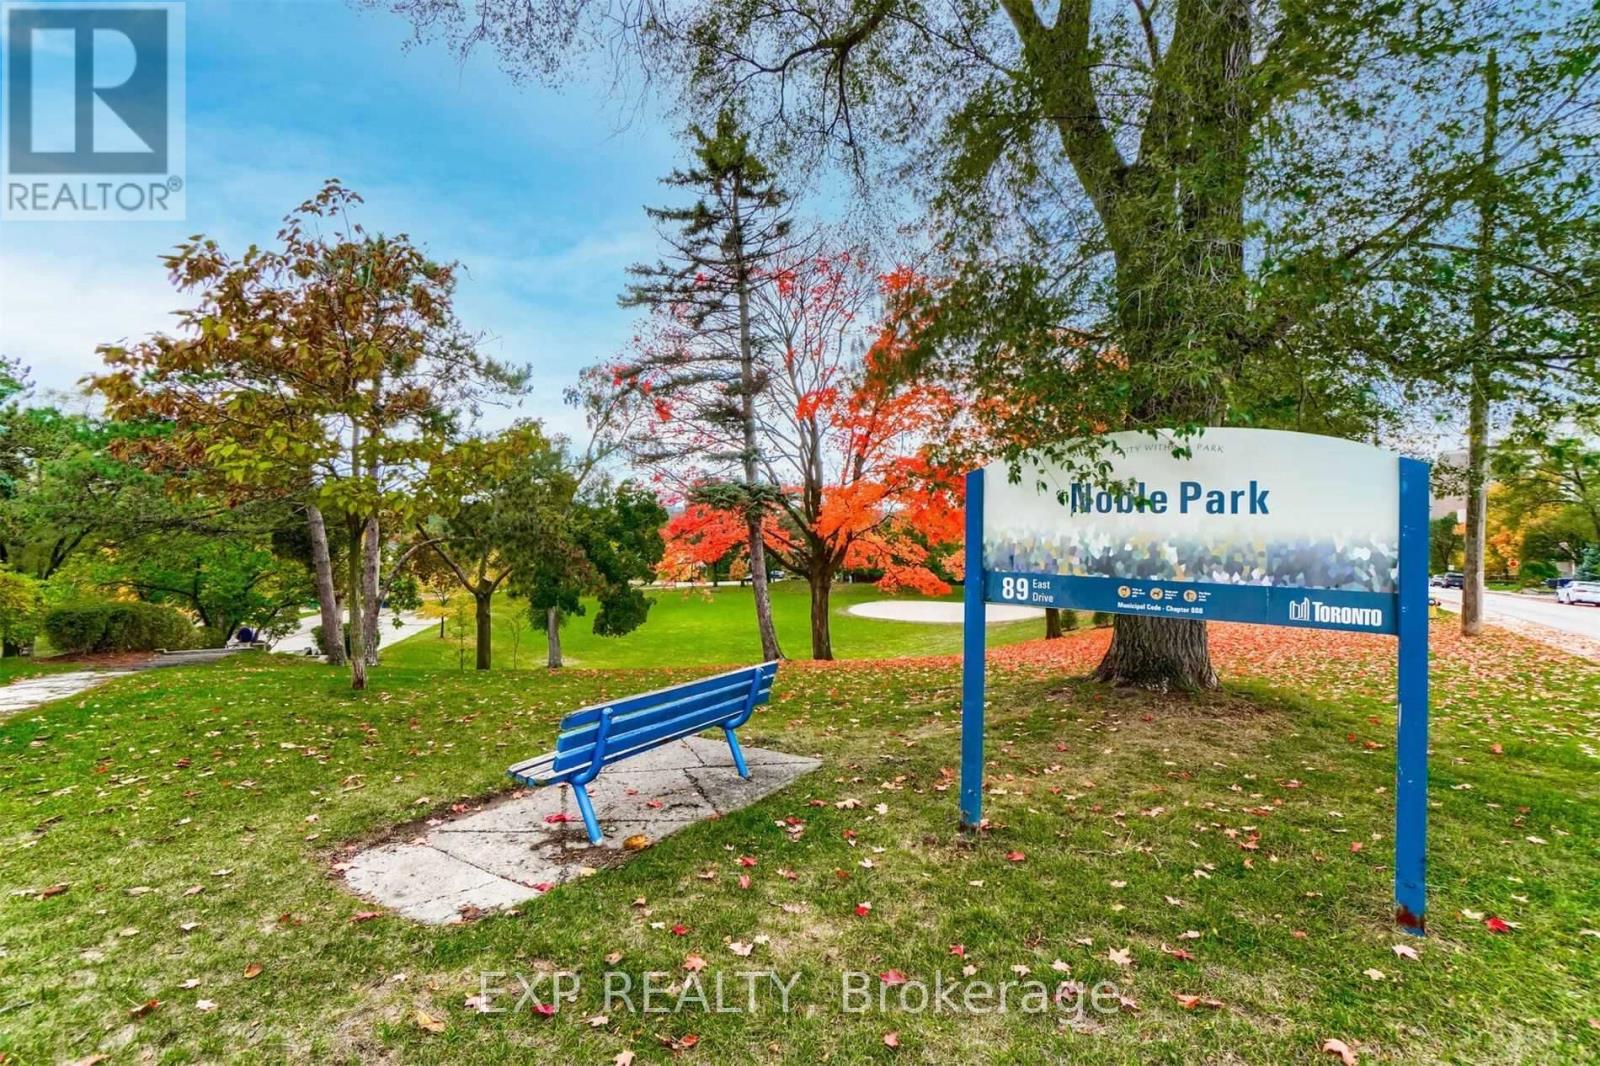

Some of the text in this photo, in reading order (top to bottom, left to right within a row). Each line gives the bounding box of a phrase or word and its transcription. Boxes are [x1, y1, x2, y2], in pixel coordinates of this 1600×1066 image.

[1196, 443, 1224, 454] PARK
[1071, 480, 1270, 515] Noble Park
[1002, 577, 1028, 600] 89
[1032, 579, 1050, 589] East
[1032, 592, 1054, 603] Drive
[1312, 601, 1382, 627] TORONTO
